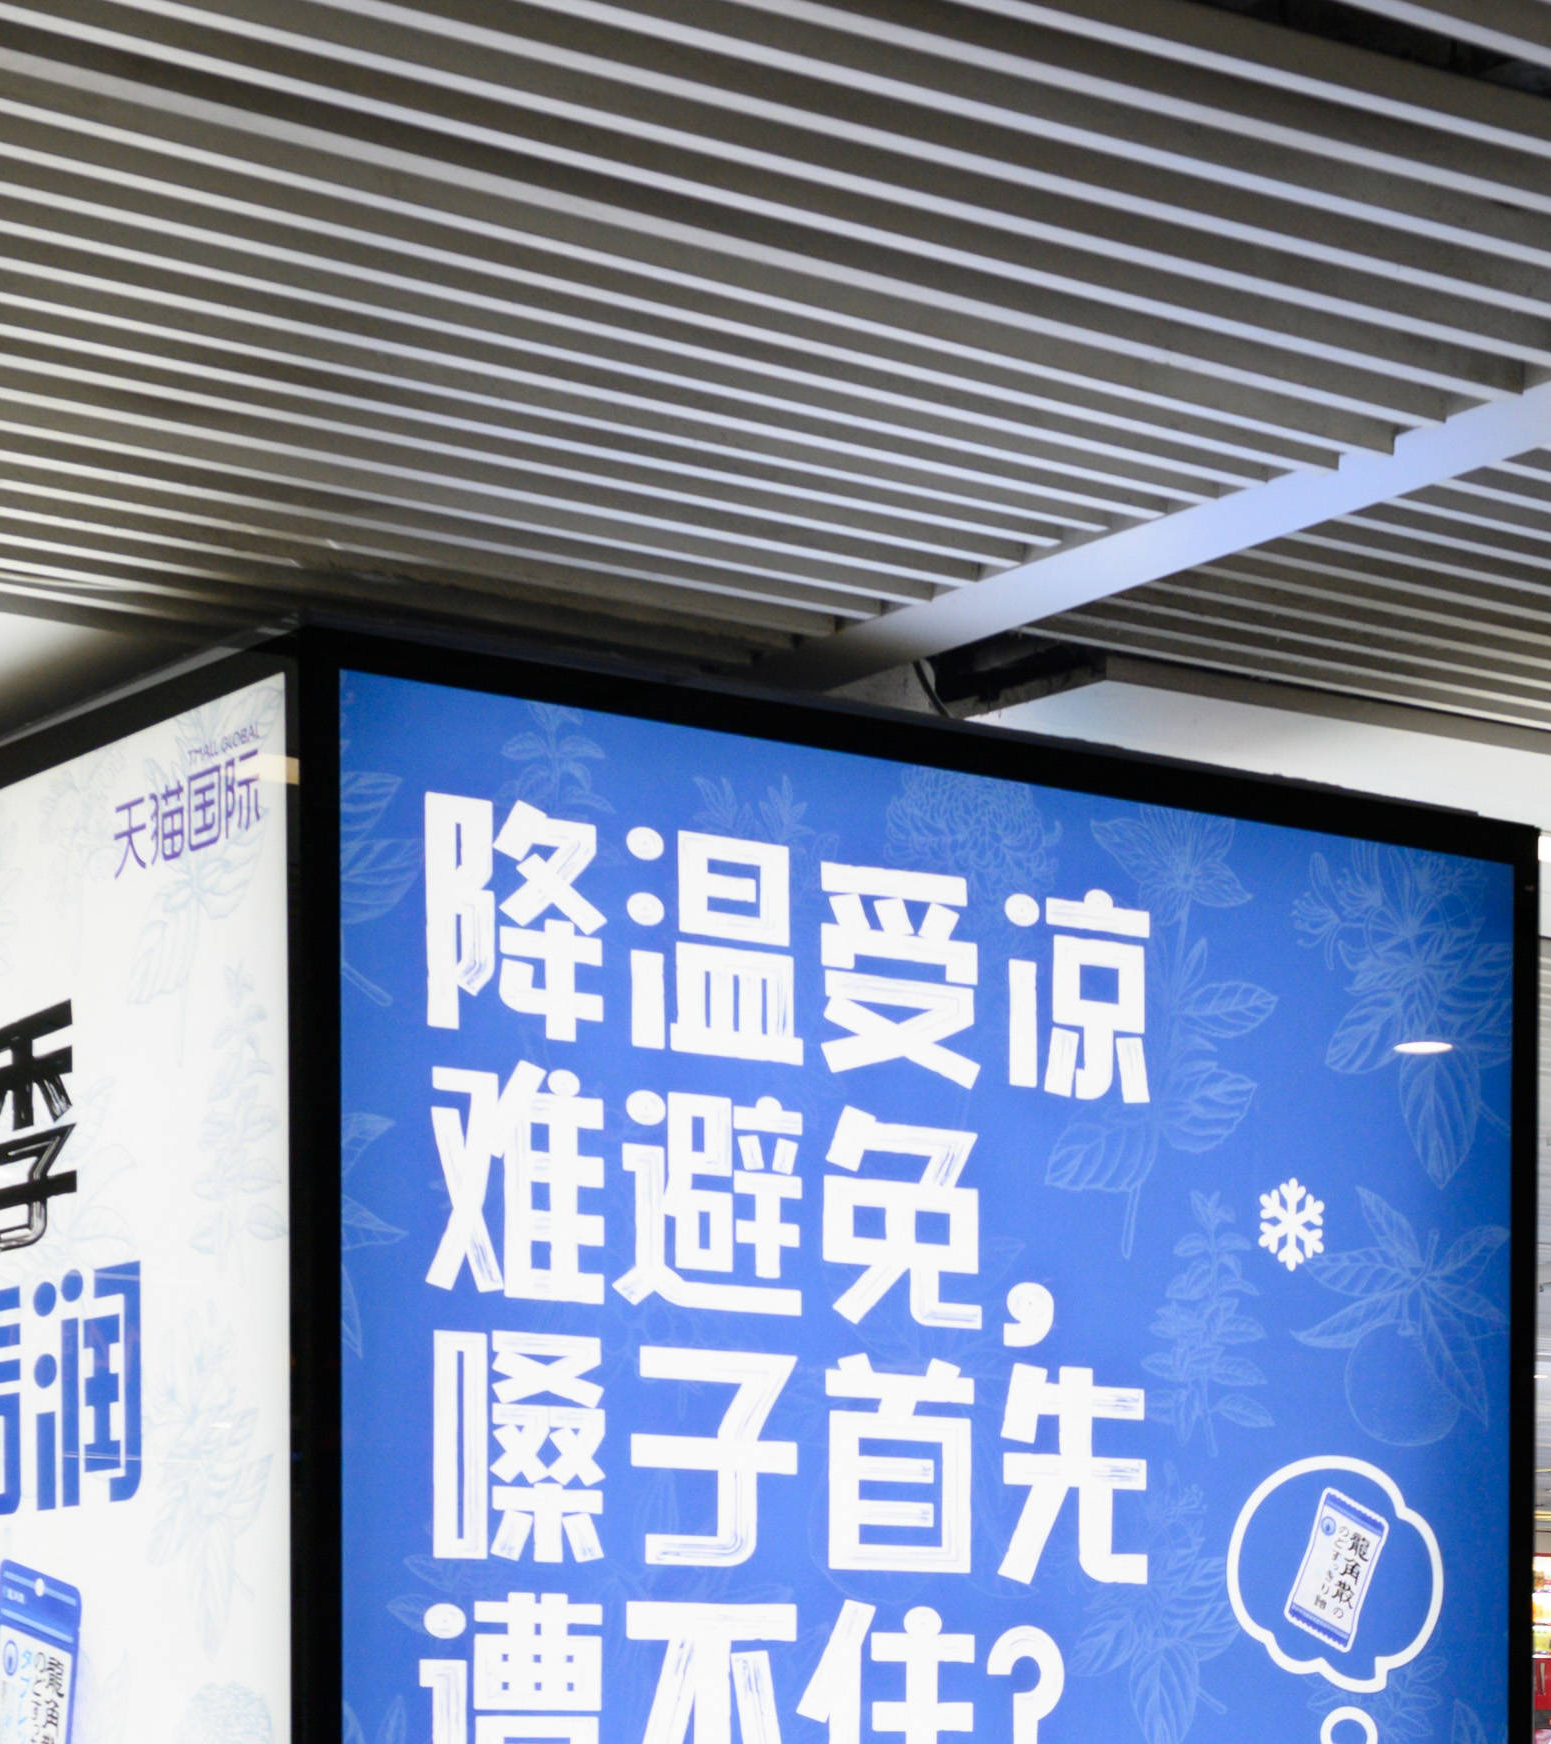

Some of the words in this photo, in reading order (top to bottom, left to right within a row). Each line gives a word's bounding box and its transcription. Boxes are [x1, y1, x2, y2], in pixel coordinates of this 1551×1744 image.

[114, 749, 261, 880] 天猫国际
[424, 790, 1151, 1104] 降温受凉
[424, 1060, 1056, 1349] 难避免，
[432, 1328, 1148, 1586] 嗓子首先
